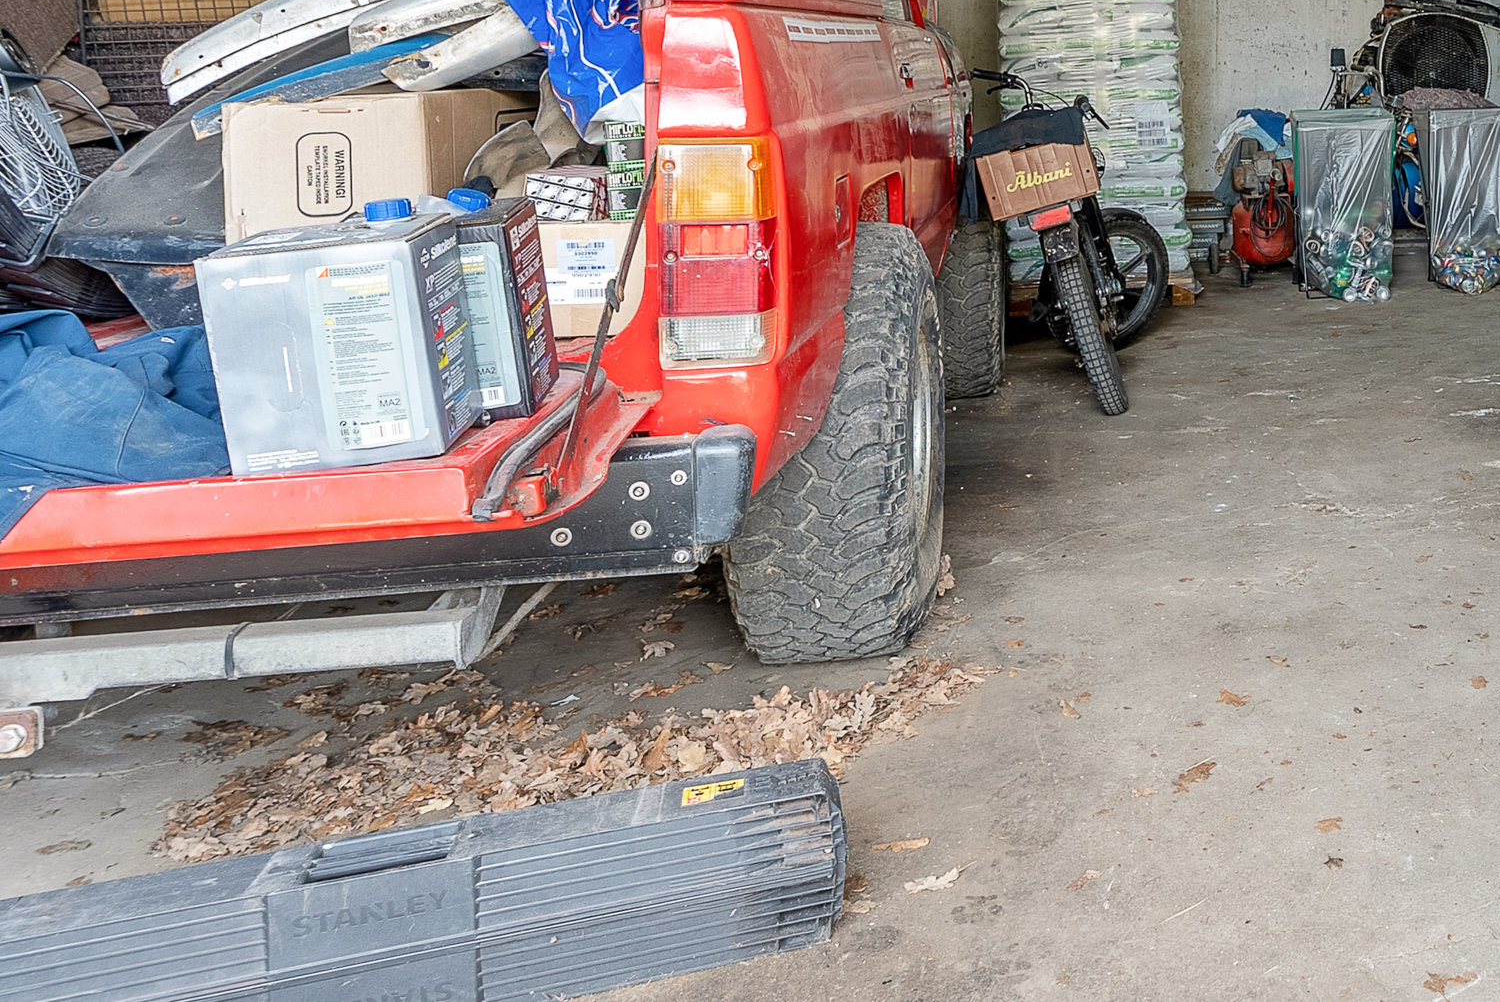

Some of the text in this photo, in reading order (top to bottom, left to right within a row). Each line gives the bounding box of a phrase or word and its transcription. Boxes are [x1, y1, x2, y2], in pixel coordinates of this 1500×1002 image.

[335, 149, 346, 199] WARNING!
[379, 398, 401, 407] MA2
[291, 888, 449, 939] STANLEY
